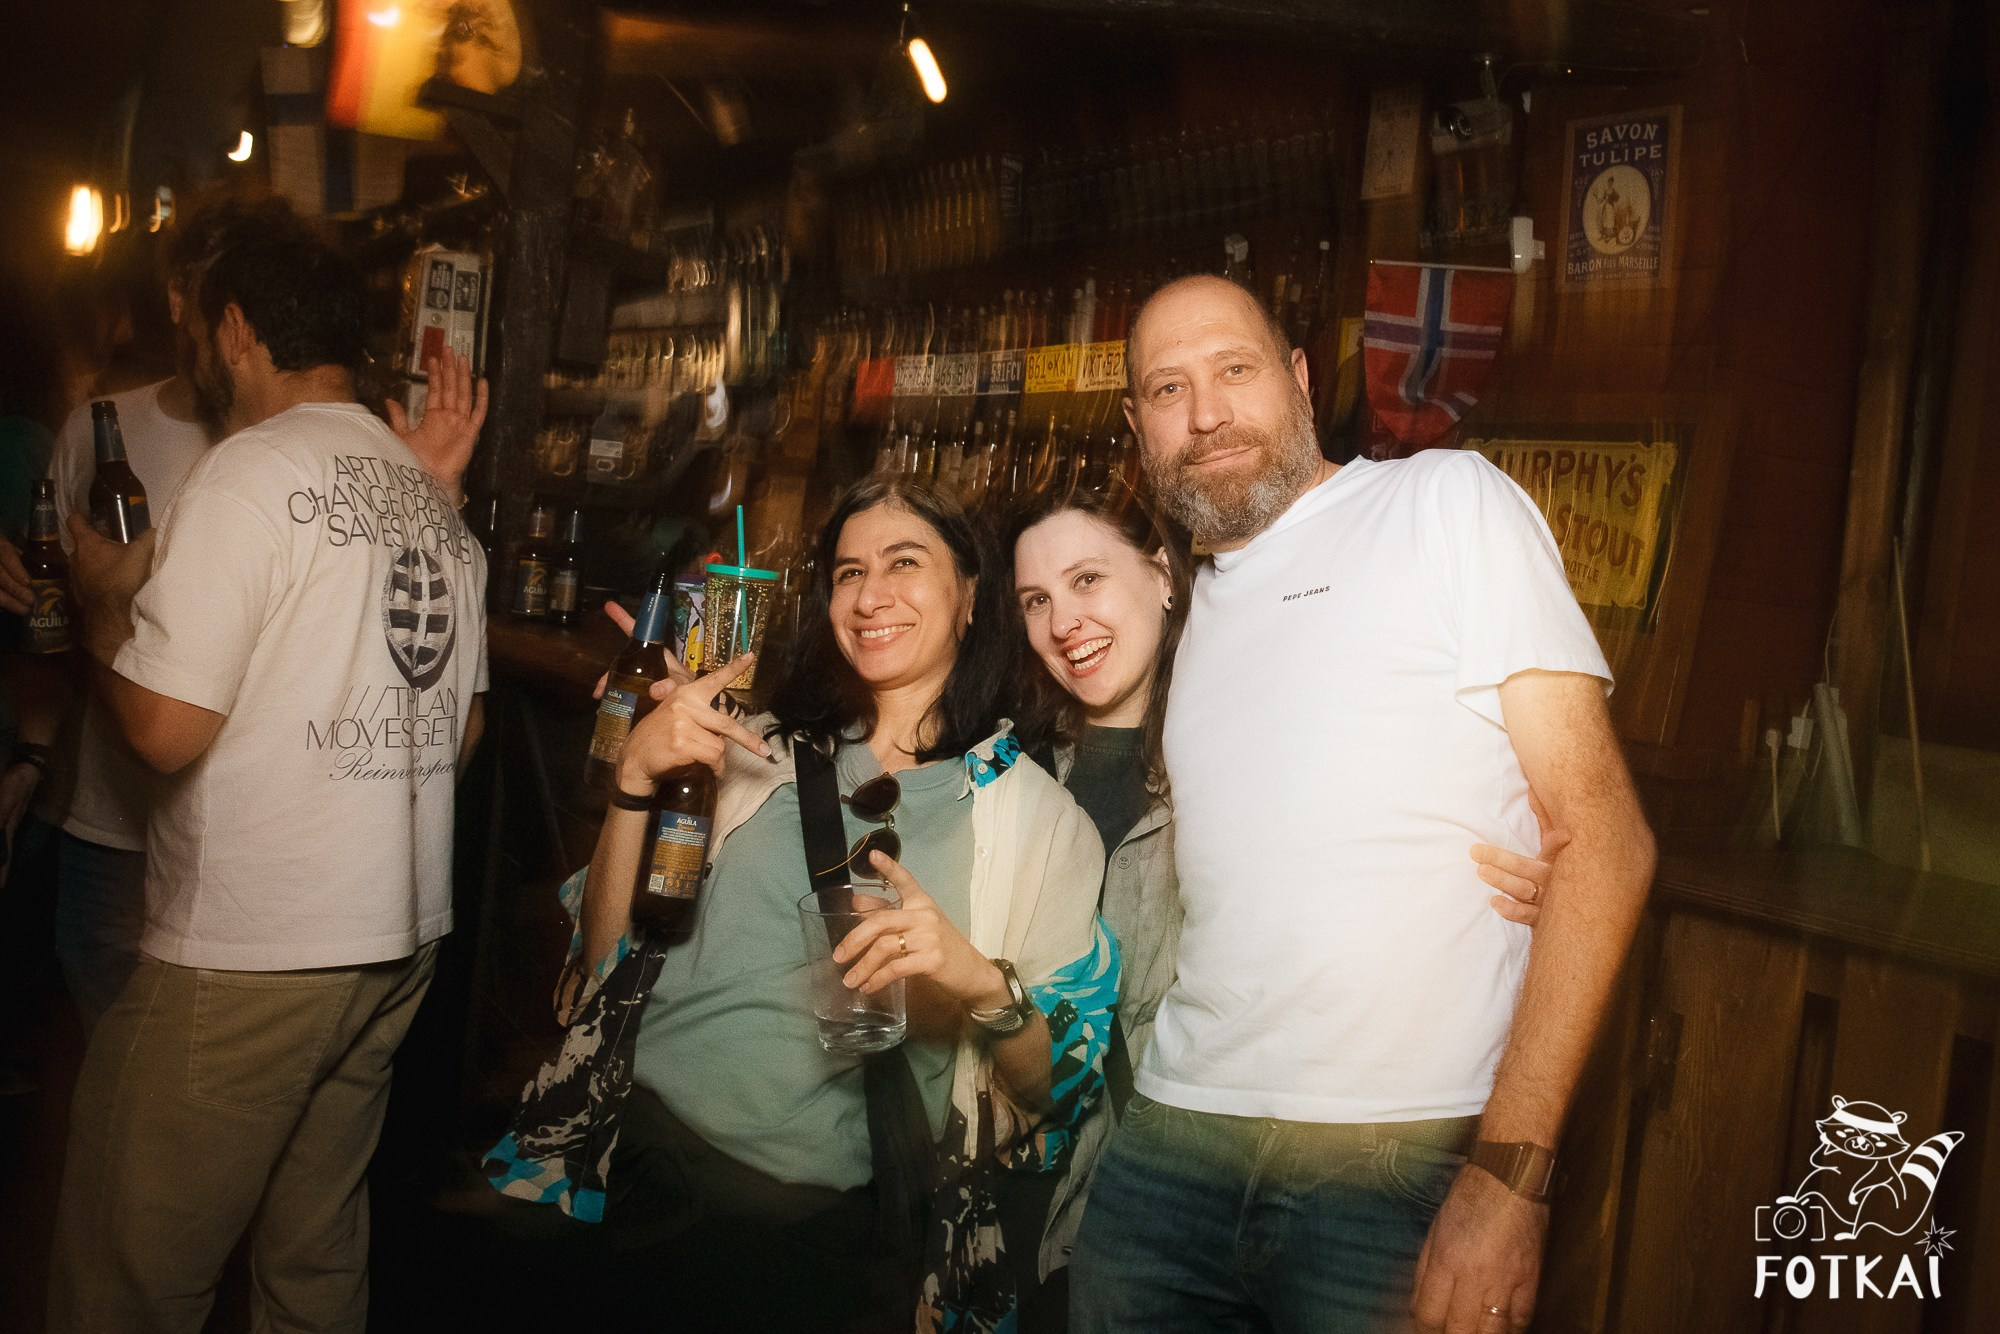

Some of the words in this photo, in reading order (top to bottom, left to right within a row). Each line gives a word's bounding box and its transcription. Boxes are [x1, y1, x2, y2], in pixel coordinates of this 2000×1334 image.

[1586, 123, 1658, 149] SAVON
[1579, 144, 1662, 167] TULIPE
[1567, 258, 1602, 275] BARON
[1618, 256, 1659, 270] MARSEILLE
[335, 455, 380, 485] ART
[288, 482, 400, 524] CHANGE
[327, 513, 404, 548] SAVES
[1556, 503, 1646, 578] STOUT
[1283, 592, 1302, 602] PEPE
[1303, 585, 1331, 597] JEANS
[29, 617, 71, 628] AGUILA
[306, 718, 411, 750] MOVES
[677, 816, 698, 827] AGUILA
